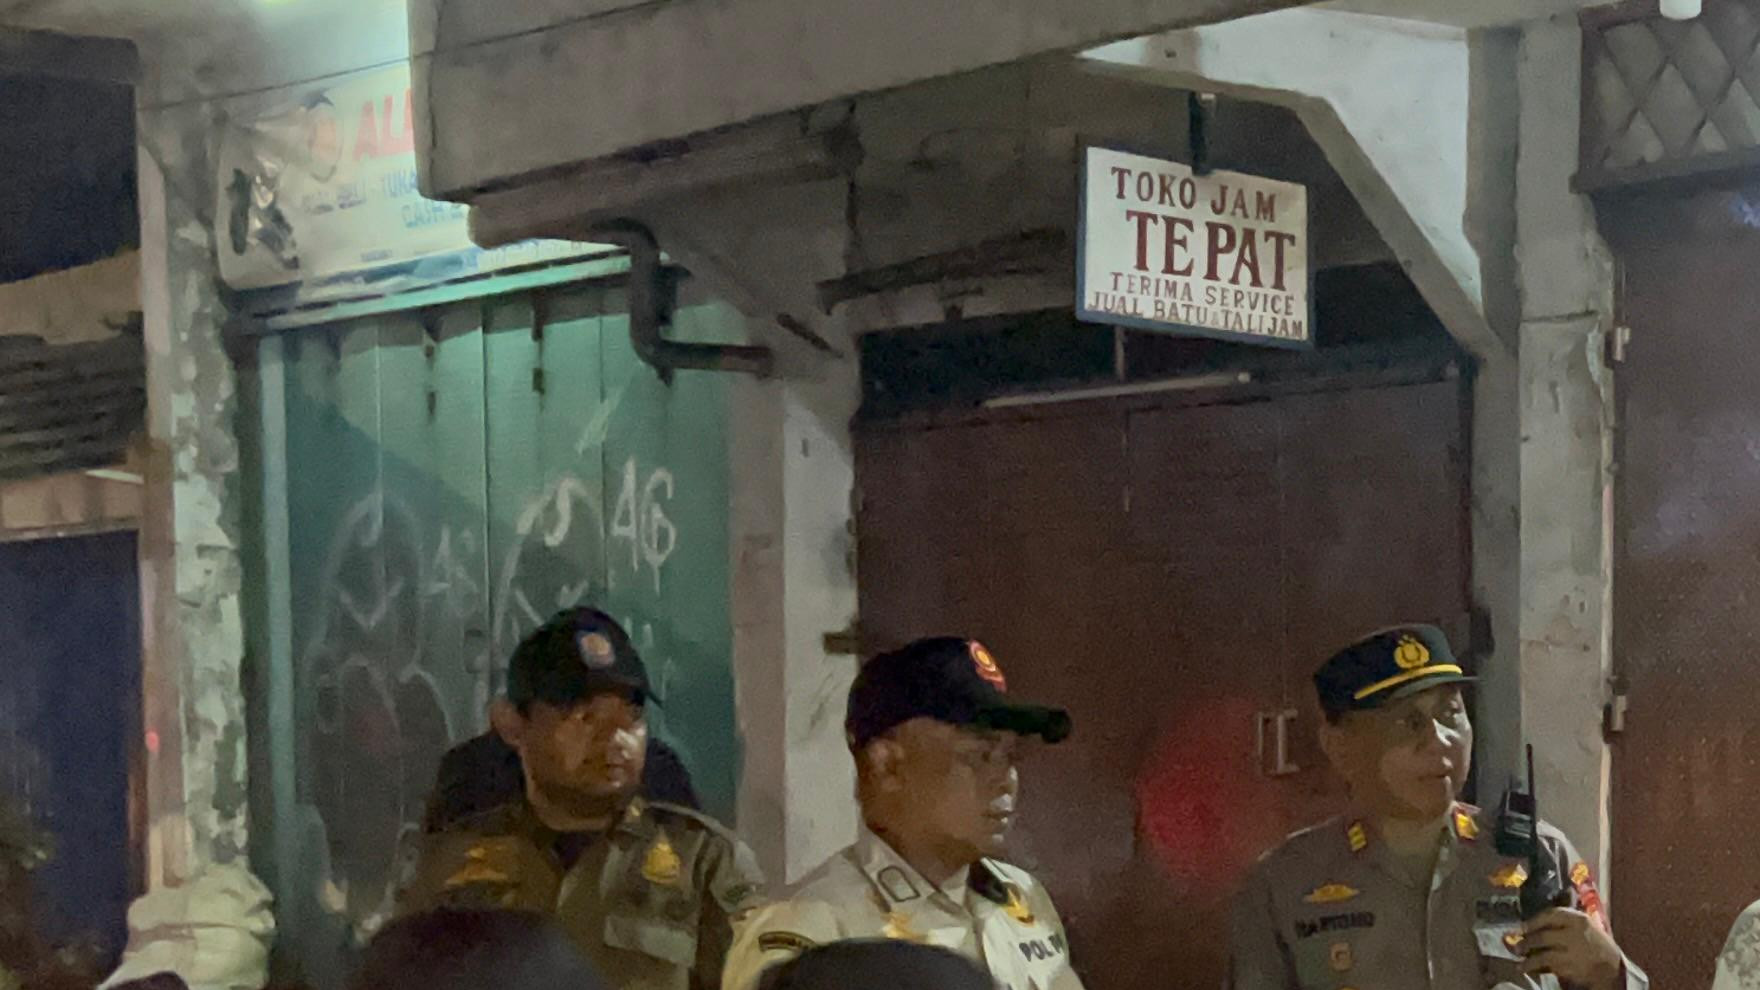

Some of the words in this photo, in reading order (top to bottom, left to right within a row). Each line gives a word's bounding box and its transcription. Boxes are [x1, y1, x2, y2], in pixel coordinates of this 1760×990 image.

[1111, 166, 1196, 210] TOKO
[1211, 185, 1276, 223] JAM
[1126, 209, 1296, 292] TEPAT
[1089, 291, 1144, 316] JUAL
[1153, 299, 1208, 324] BATU
[1221, 309, 1264, 333] TALI
[1266, 316, 1303, 338] JAM
[1109, 271, 1193, 302] TERIMA
[1205, 285, 1295, 316] SERVICE
